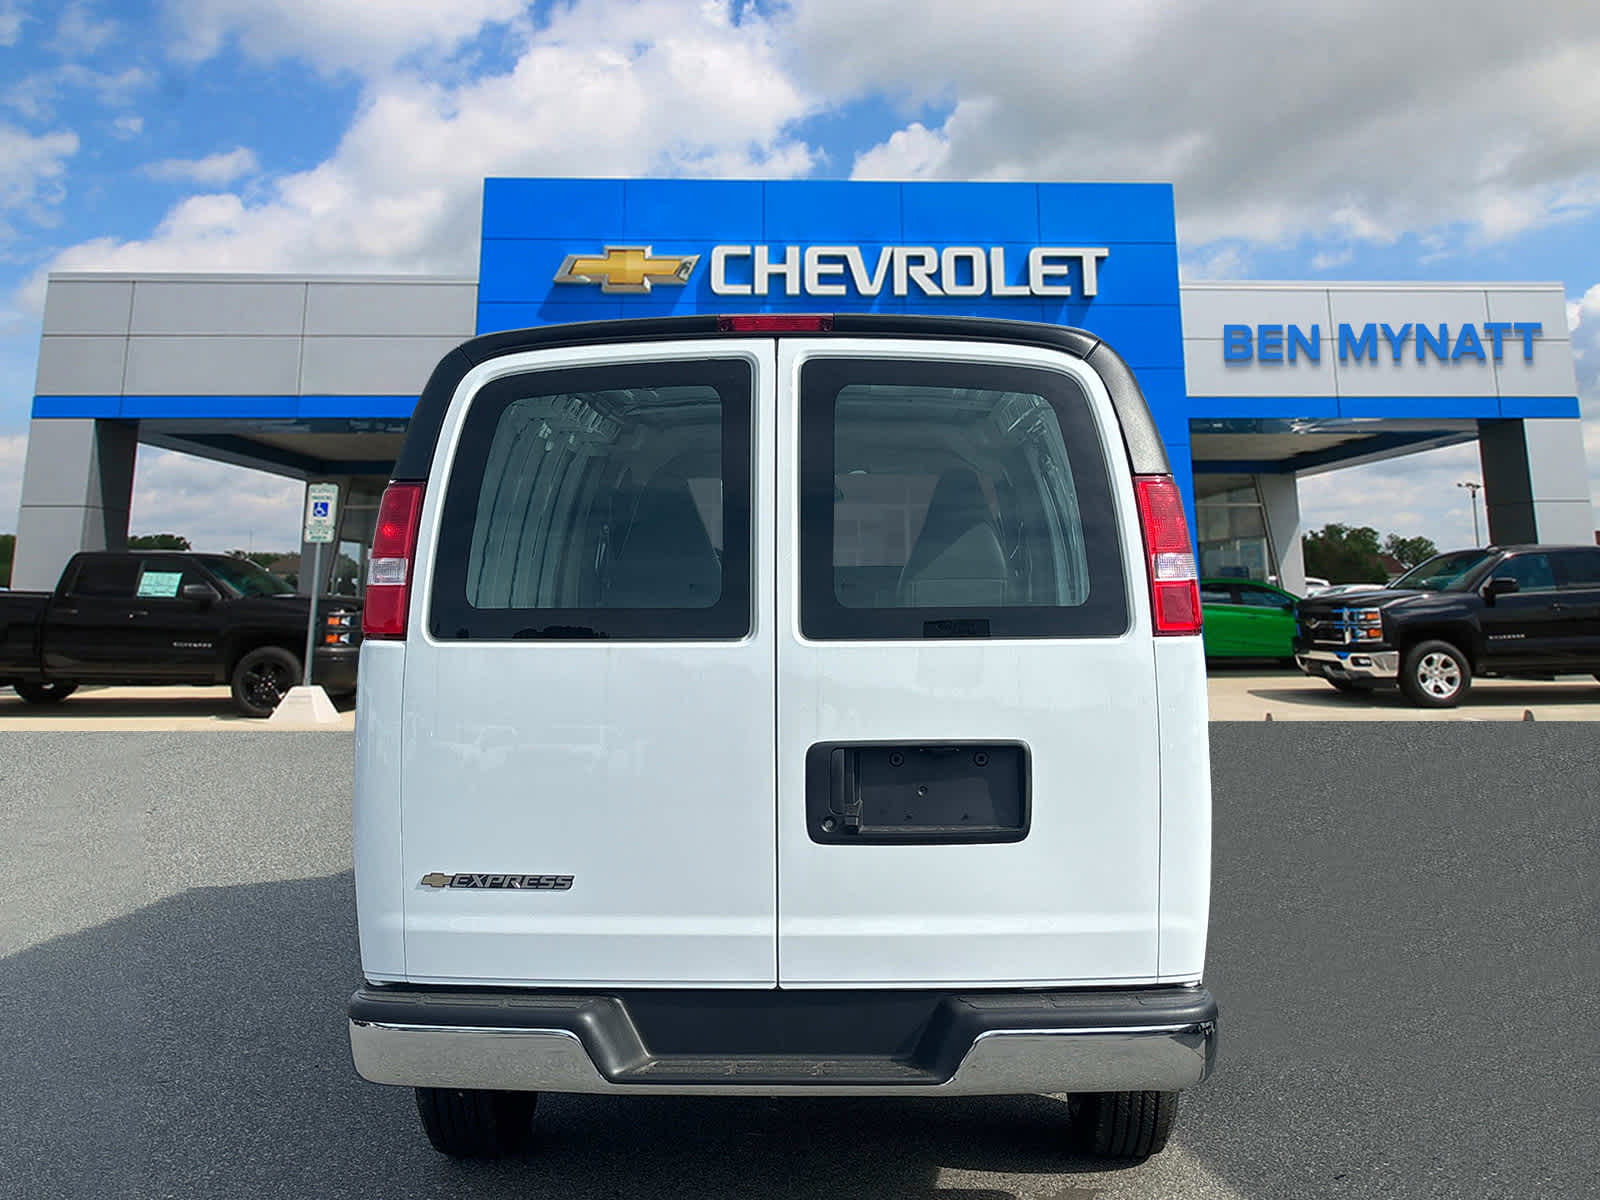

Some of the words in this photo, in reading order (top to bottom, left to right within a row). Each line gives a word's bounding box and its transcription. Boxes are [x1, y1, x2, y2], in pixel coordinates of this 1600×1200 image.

[709, 245, 1110, 296] CHEVROLET
[1223, 324, 1321, 363] BEN
[1338, 322, 1543, 363] MYNATT
[450, 873, 575, 890] EXPRESS
